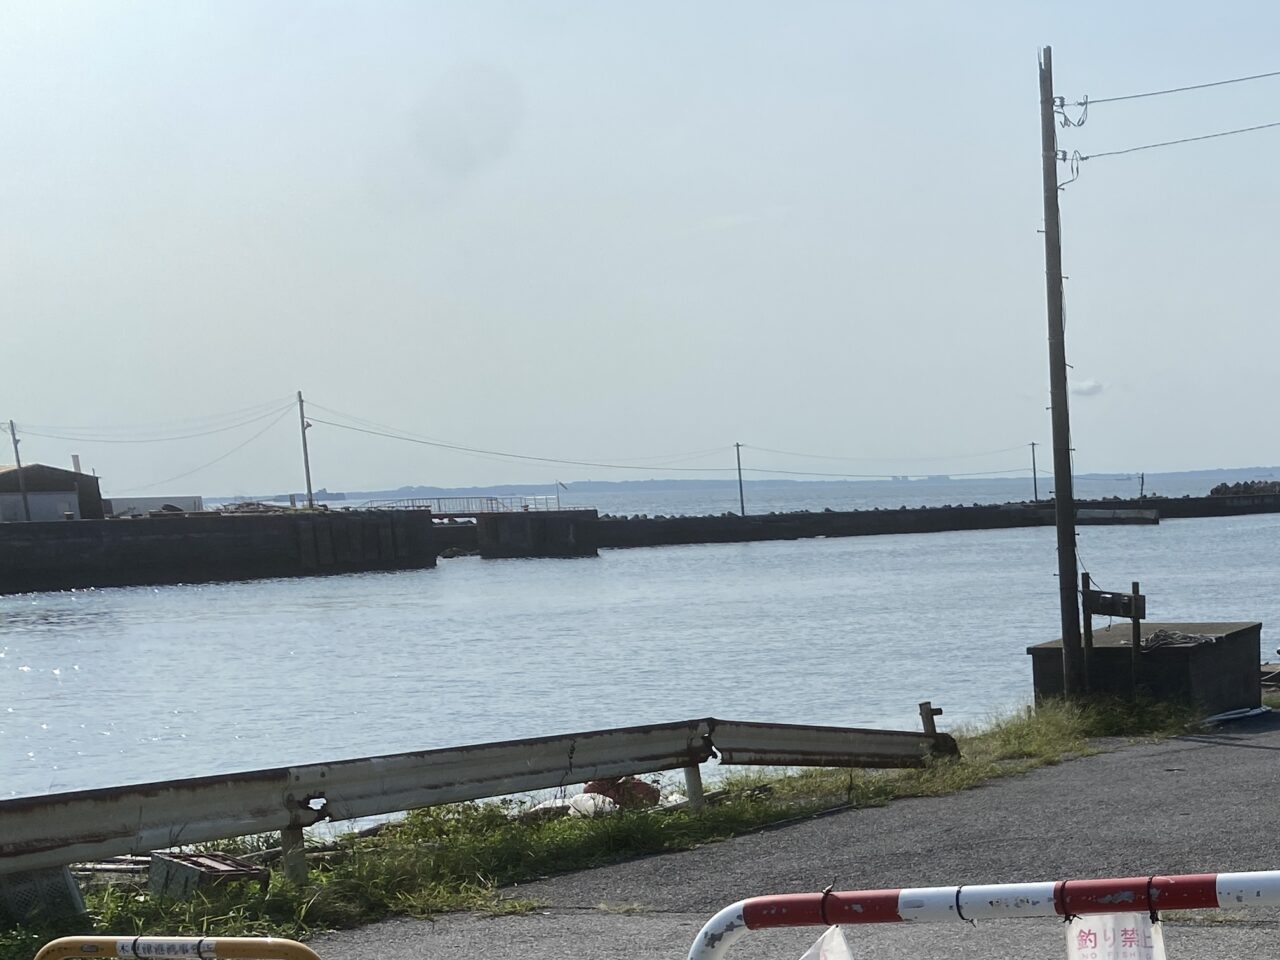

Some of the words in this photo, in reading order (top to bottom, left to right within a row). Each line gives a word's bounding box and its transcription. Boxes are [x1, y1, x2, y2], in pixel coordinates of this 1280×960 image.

[1077, 928, 1154, 950] 釣り禁止
[1081, 952, 1098, 960] NO
